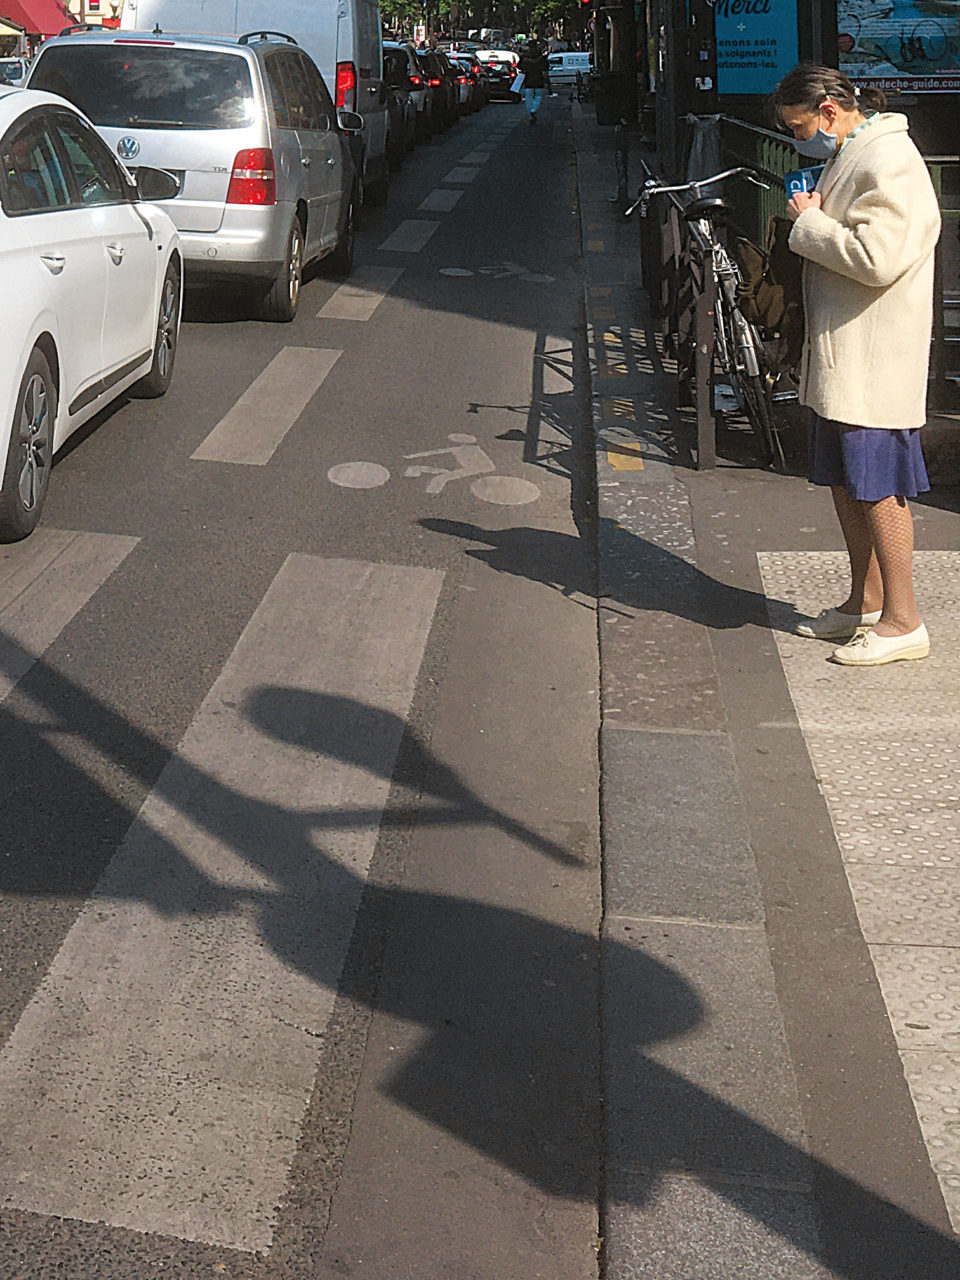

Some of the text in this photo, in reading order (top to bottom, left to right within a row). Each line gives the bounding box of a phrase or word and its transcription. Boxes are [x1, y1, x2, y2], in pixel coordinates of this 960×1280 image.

[718, 37, 777, 47] enons soin
[716, 60, 778, 69] utenons-les.
[851, 78, 960, 90] ww.ardeche-guide.com
